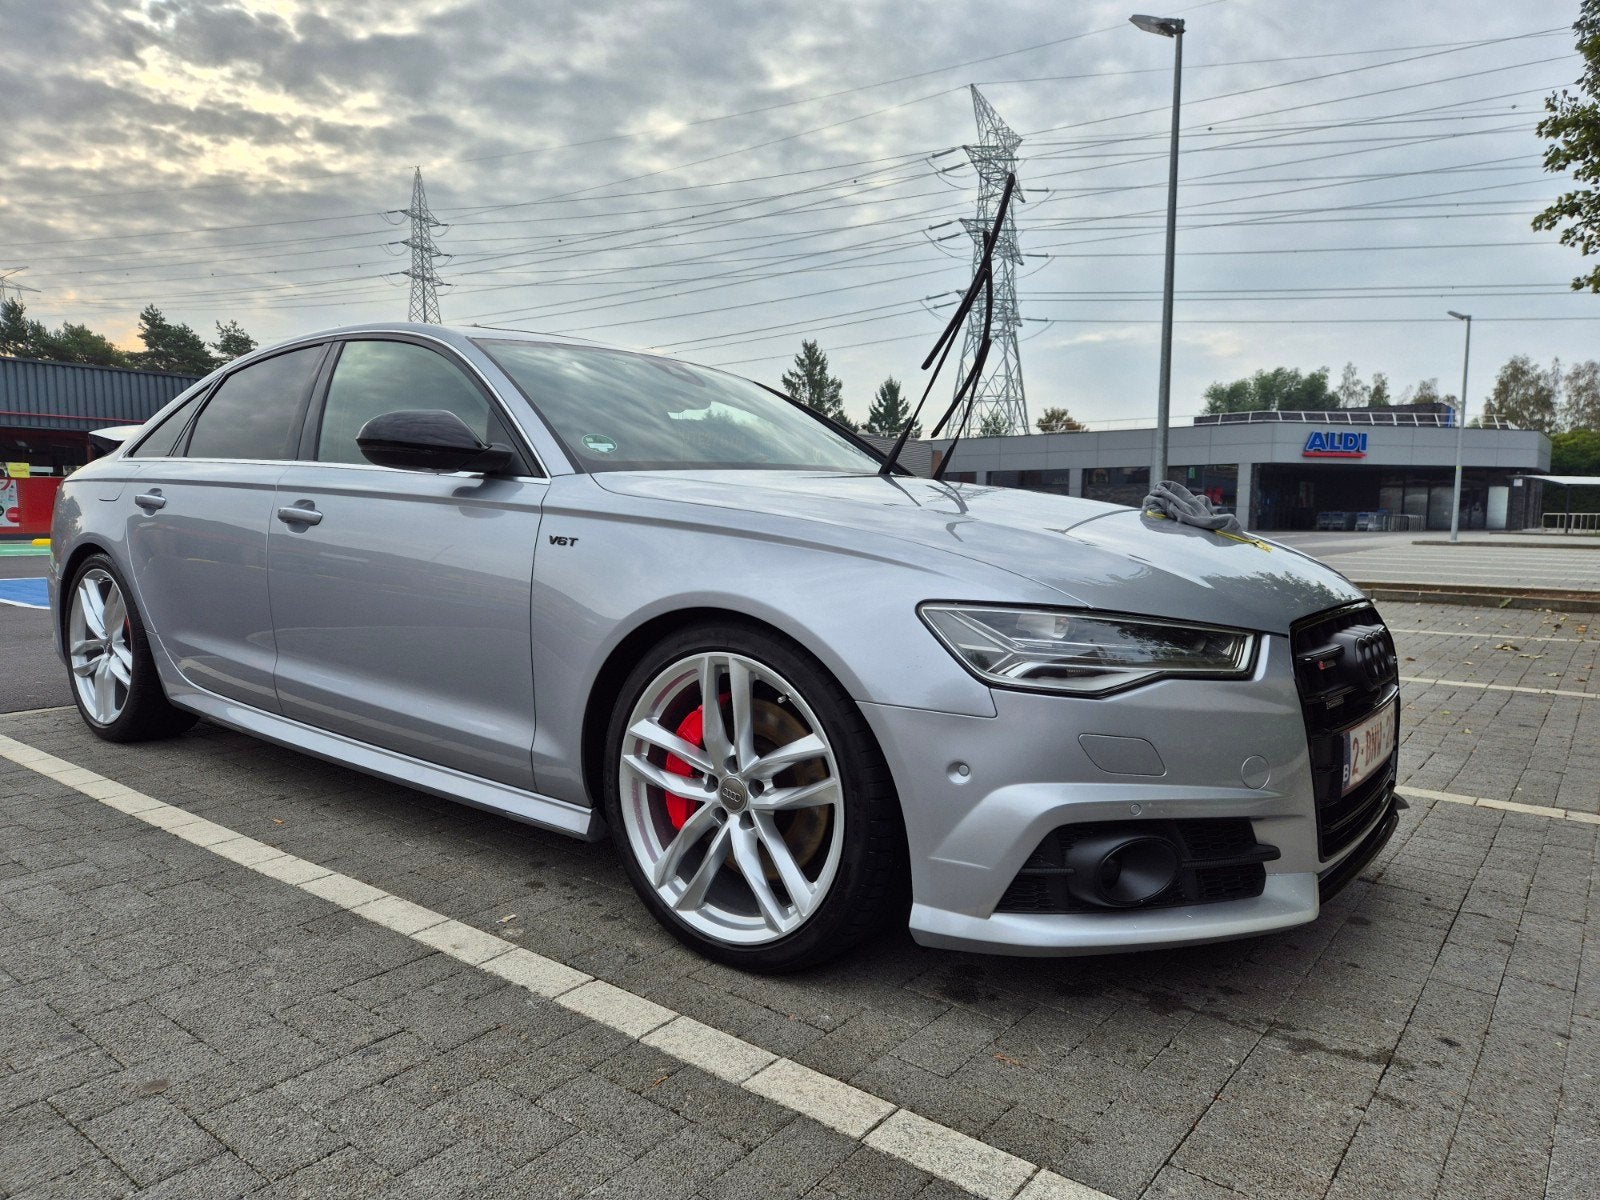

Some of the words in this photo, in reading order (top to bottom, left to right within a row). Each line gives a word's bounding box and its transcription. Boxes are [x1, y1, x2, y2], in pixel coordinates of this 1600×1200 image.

[1305, 431, 1368, 452] ALDI
[549, 535, 579, 547] V6T
[1343, 764, 1351, 782] B
